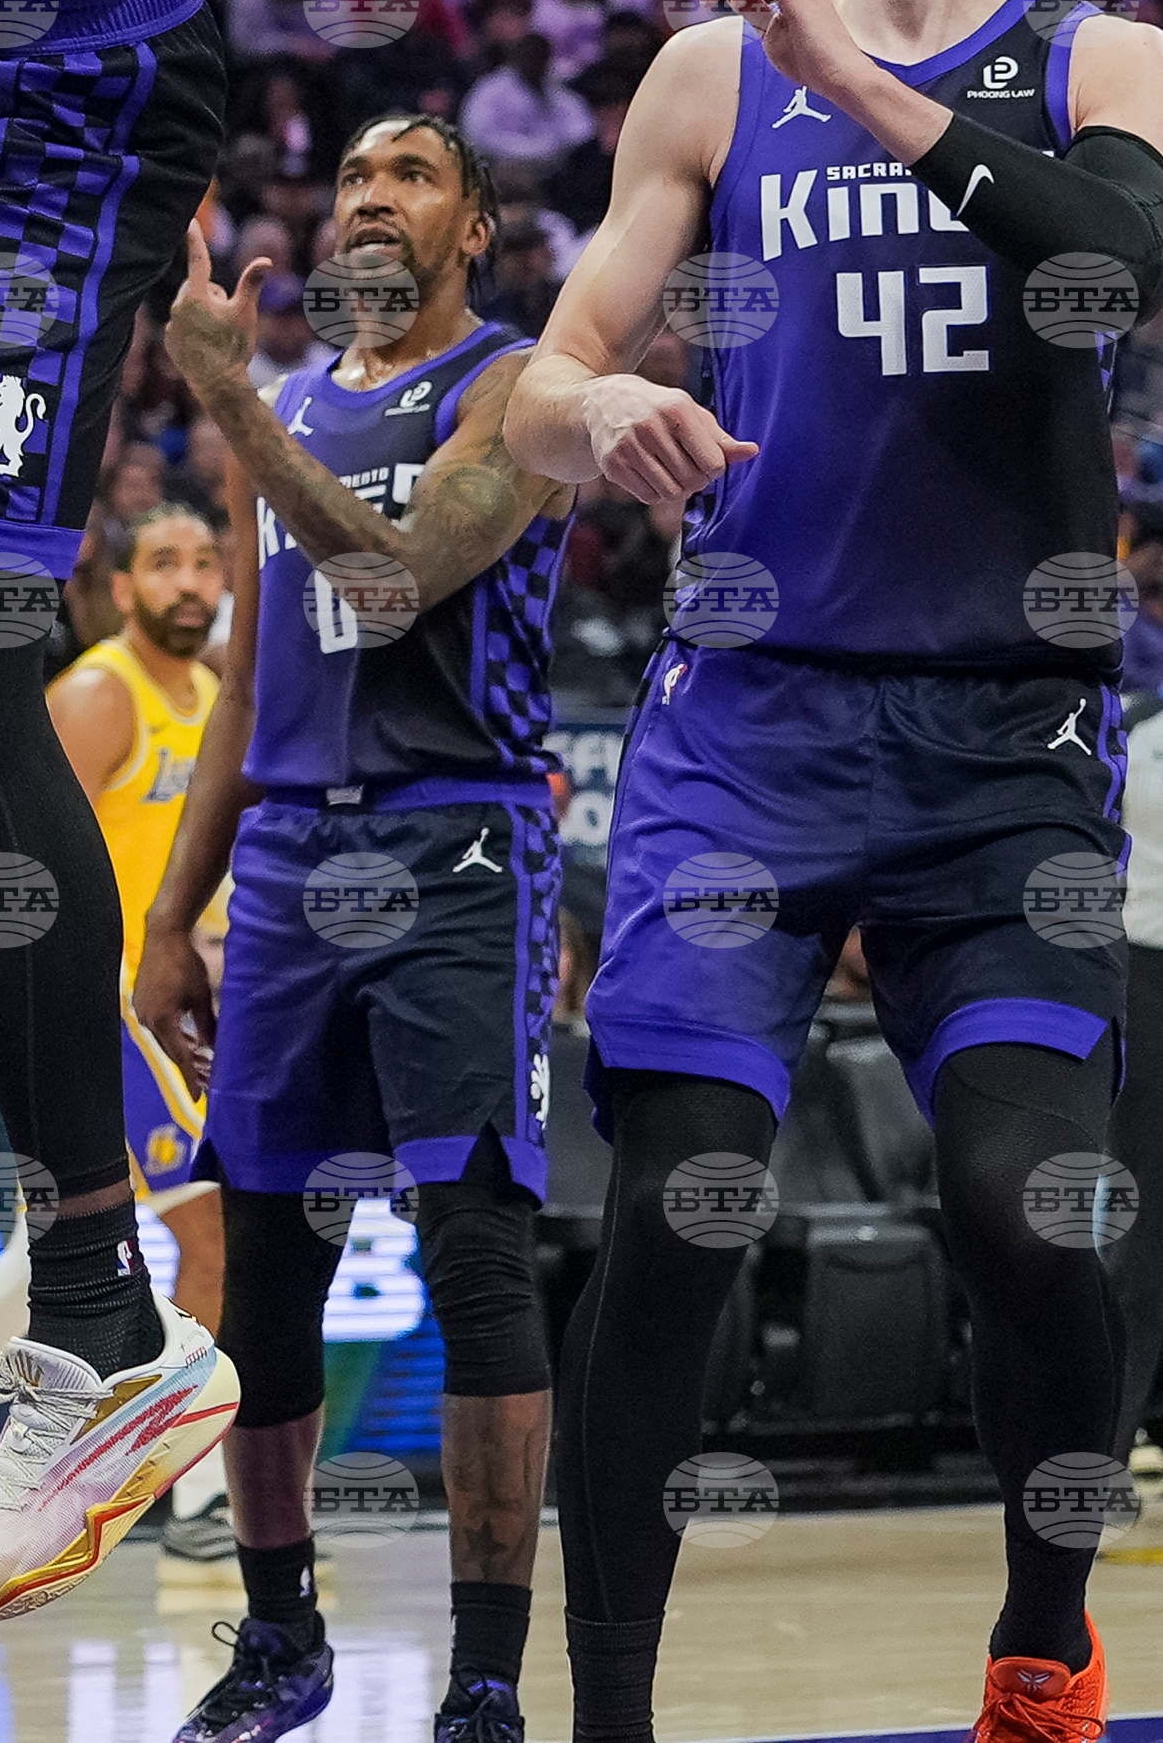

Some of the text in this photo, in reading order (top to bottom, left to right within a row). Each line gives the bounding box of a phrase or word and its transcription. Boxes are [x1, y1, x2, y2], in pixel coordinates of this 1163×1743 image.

[967, 88, 1035, 99] PHOONG LAW
[826, 161, 912, 181] SACRA
[836, 265, 989, 376] 42
